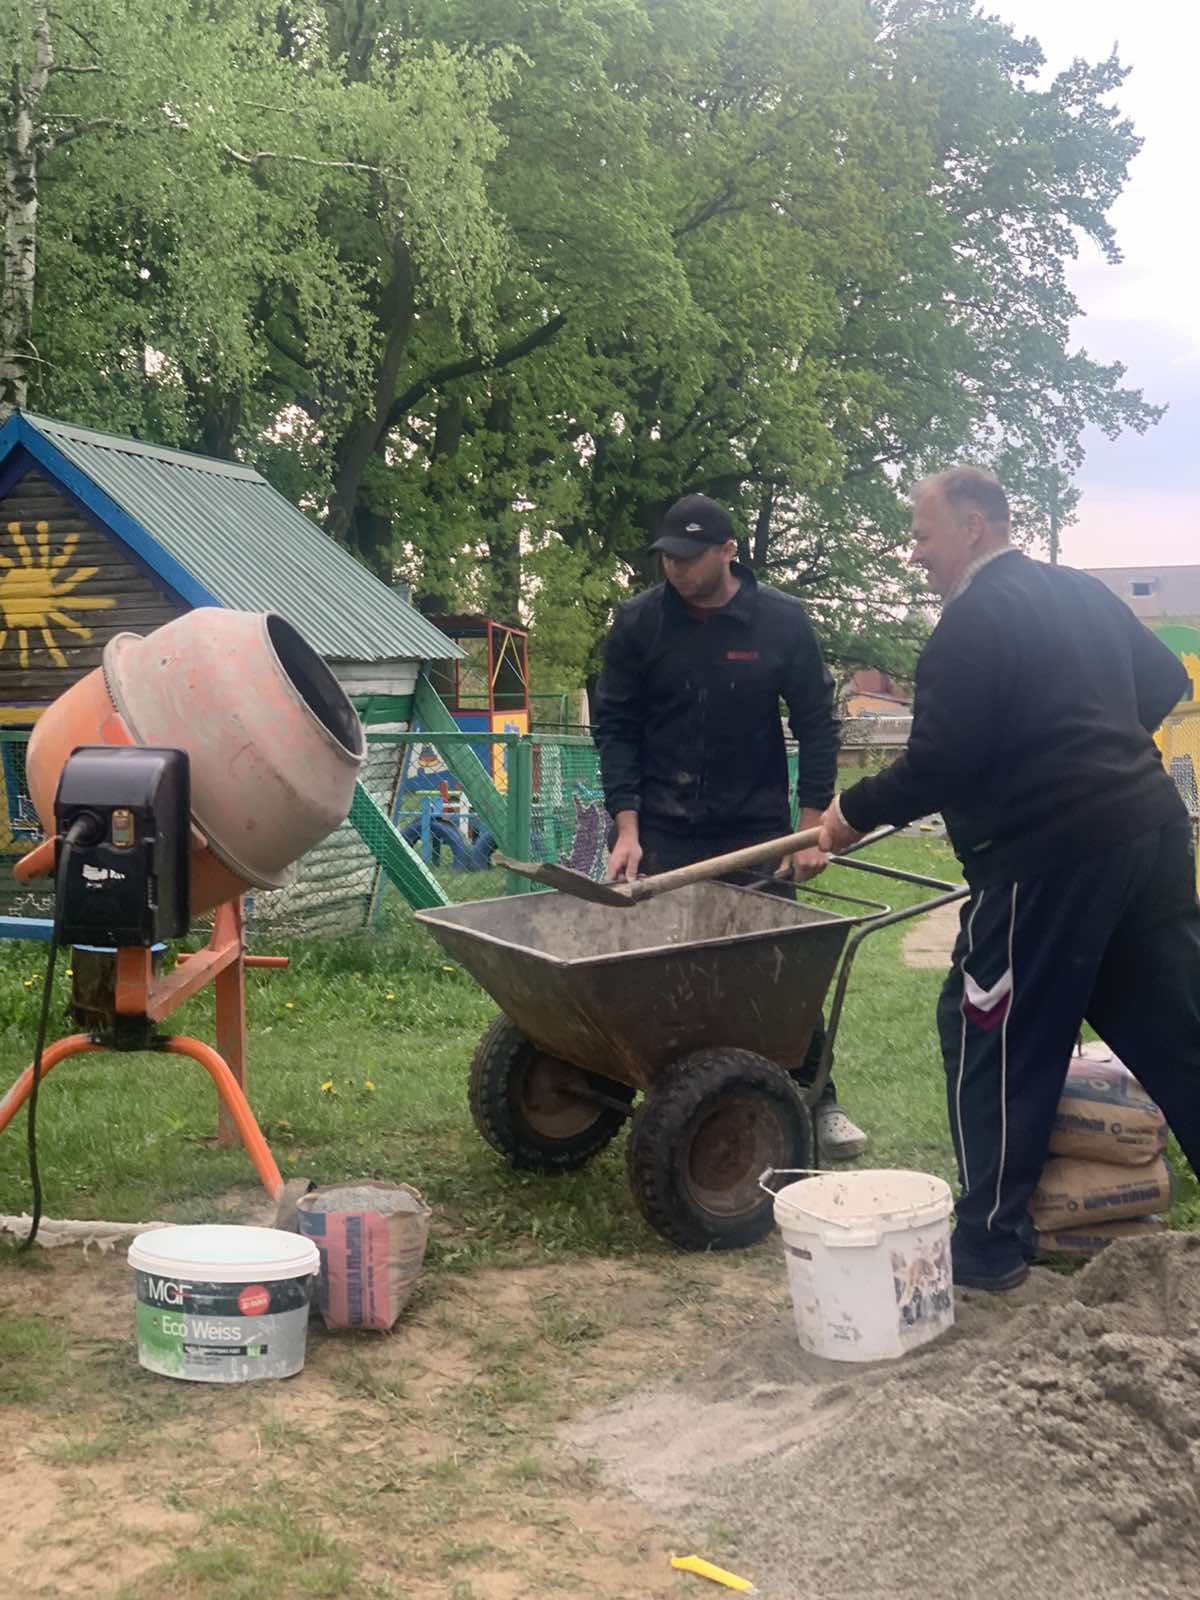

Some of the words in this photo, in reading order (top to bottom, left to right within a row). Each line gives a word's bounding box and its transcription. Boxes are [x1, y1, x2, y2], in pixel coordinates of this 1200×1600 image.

[149, 1277, 192, 1305] MGF
[162, 1315, 187, 1337] Eco
[191, 1320, 242, 1341] Weiss
